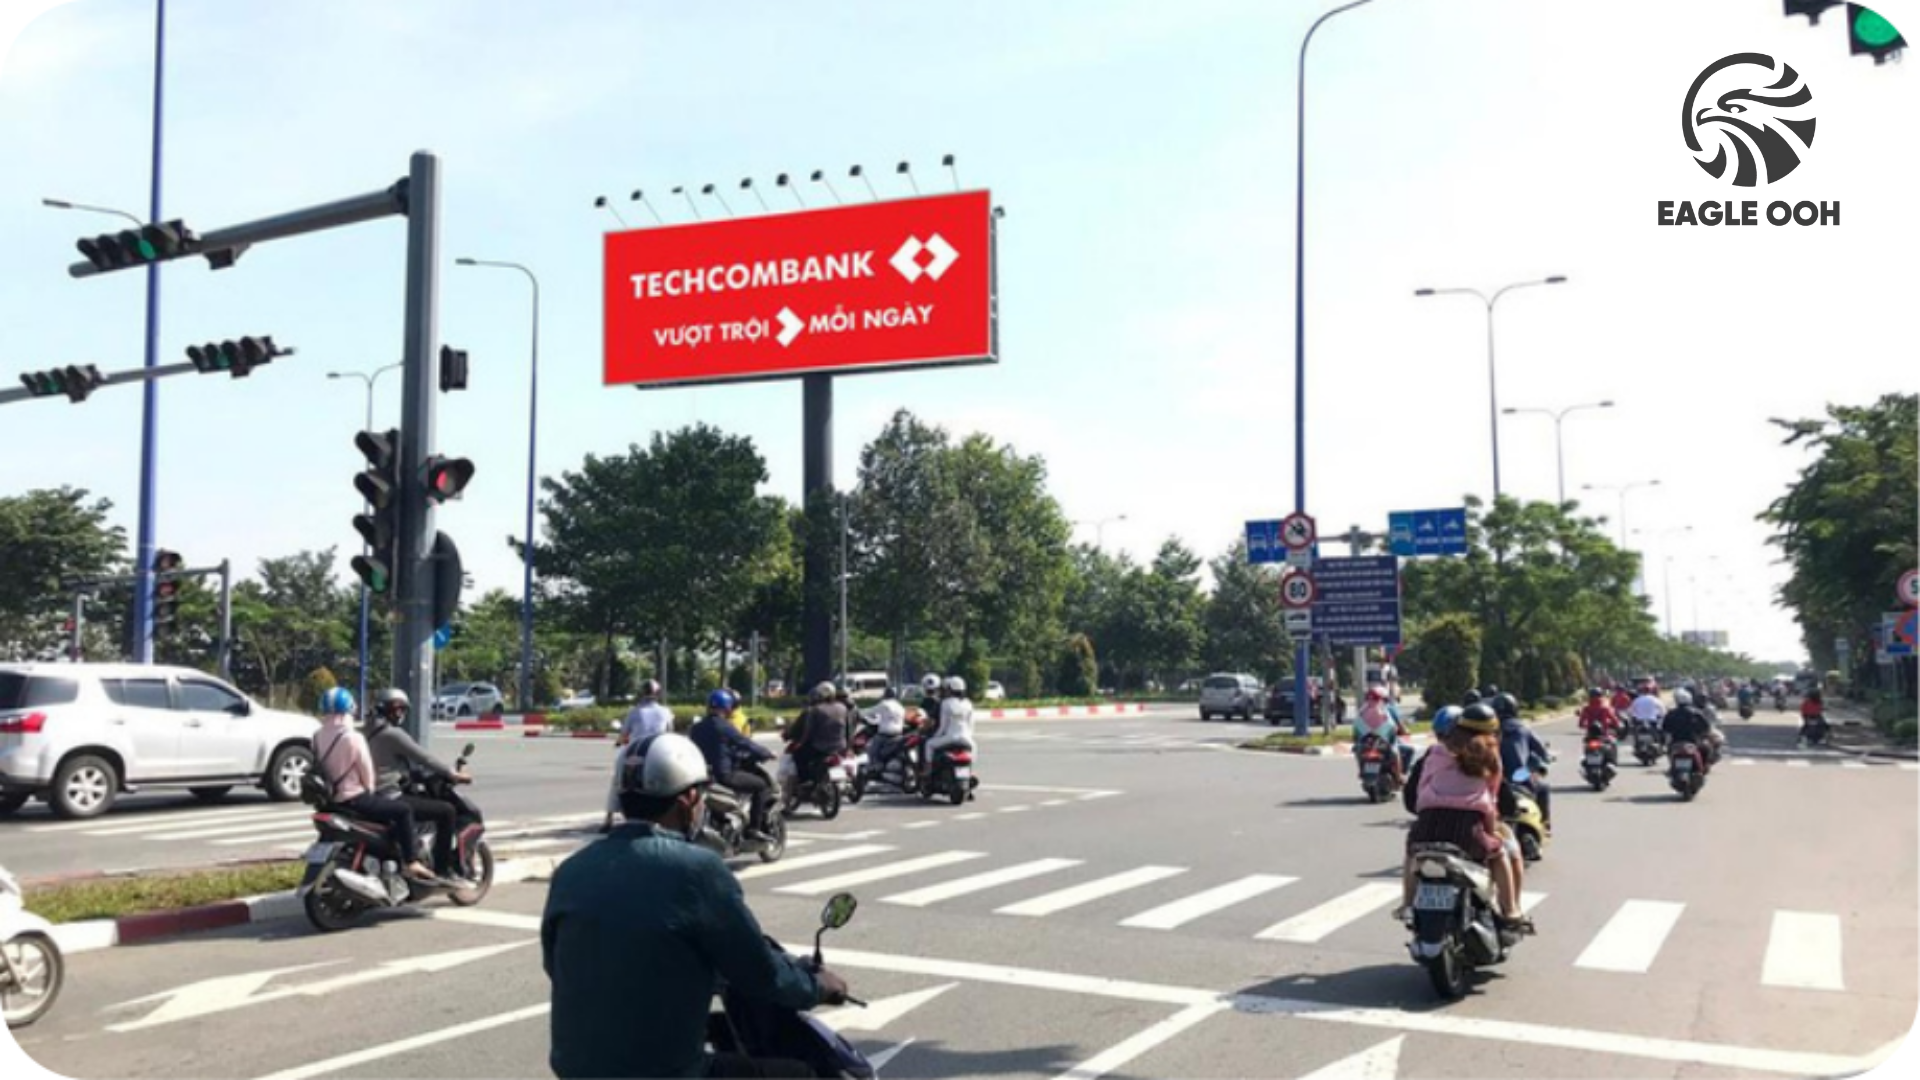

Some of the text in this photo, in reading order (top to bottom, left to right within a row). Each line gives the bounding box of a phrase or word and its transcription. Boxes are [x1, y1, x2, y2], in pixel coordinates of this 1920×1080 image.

[630, 250, 875, 299] TECHCOMBANK
[653, 323, 713, 349] VƯỢT
[719, 316, 770, 343] TRỘI
[863, 301, 934, 329] NGÀY
